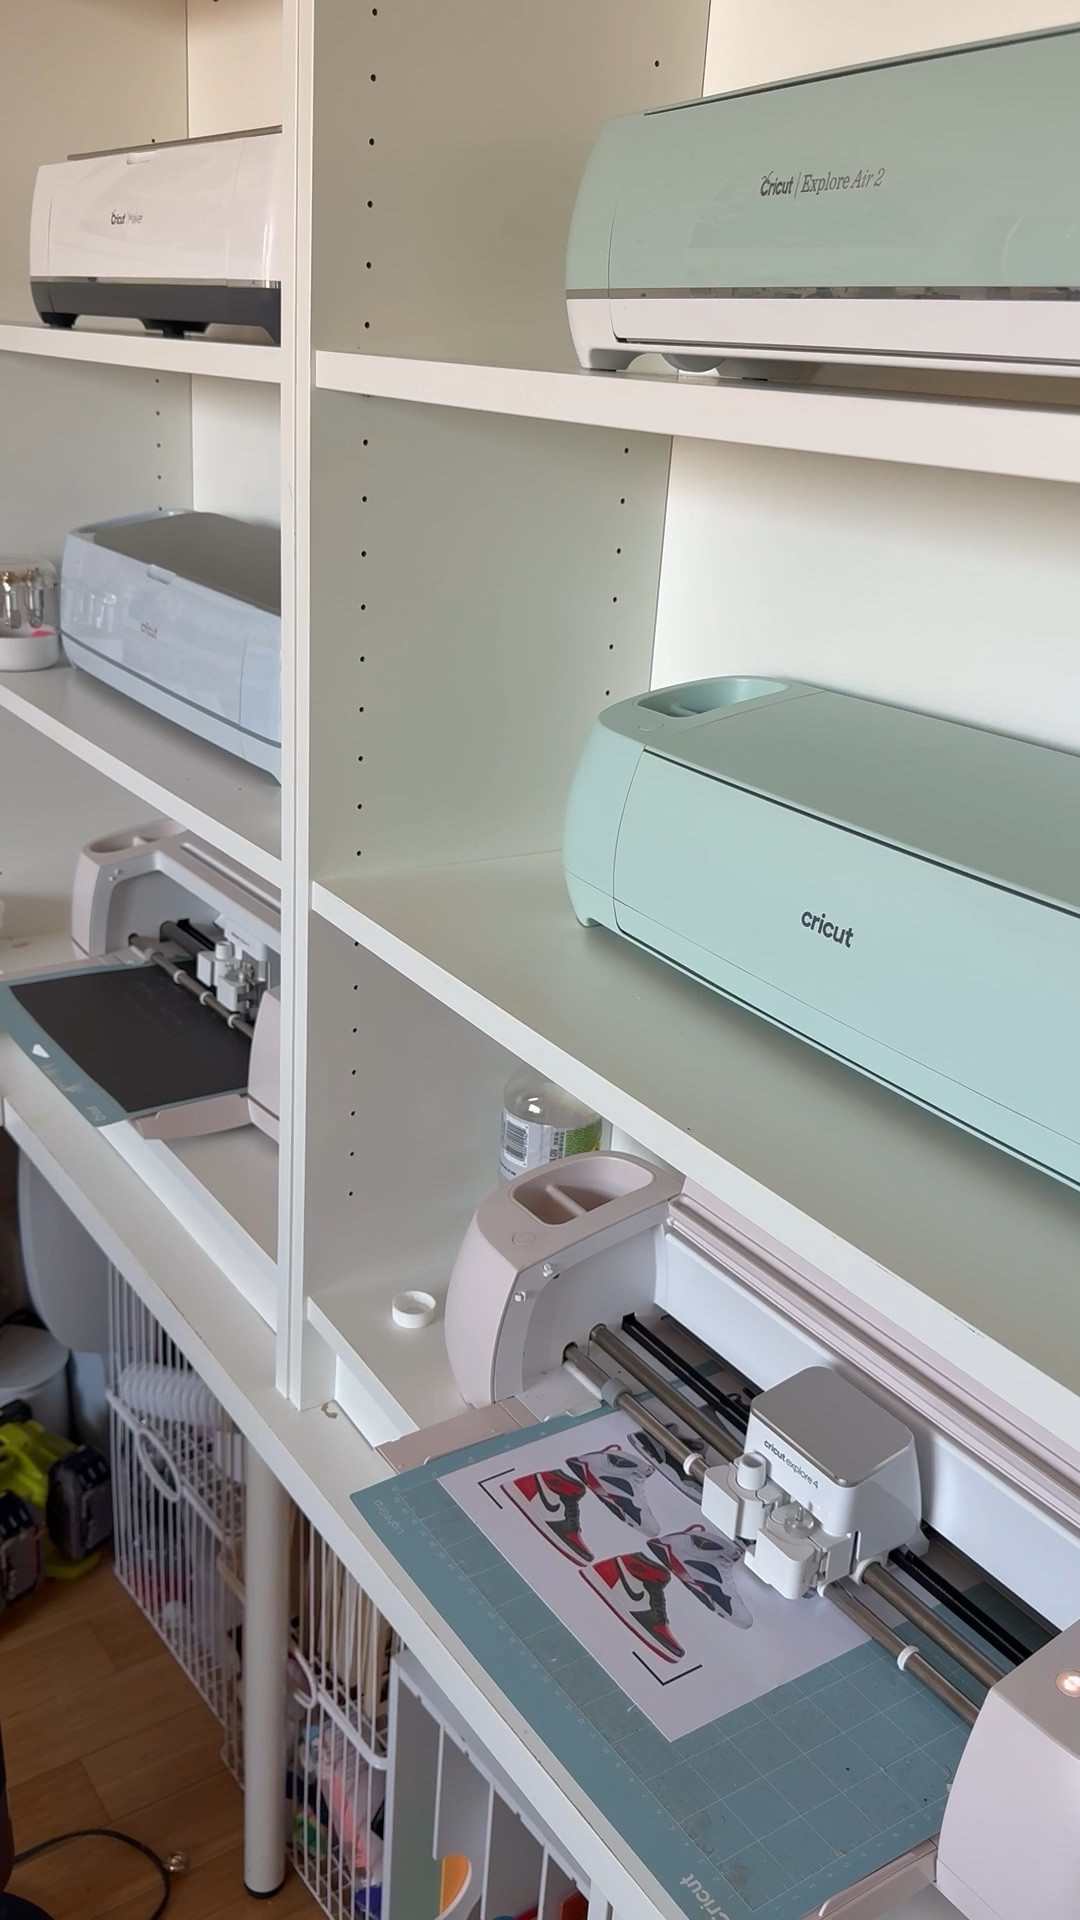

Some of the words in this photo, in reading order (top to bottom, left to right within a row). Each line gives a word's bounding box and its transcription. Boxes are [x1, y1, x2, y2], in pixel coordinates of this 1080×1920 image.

[760, 171, 794, 197] Cricut
[801, 172, 850, 195] Explore
[850, 169, 874, 189] Air
[874, 167, 885, 187] 2
[801, 910, 854, 948] cricut
[764, 1440, 786, 1463] cricut
[785, 1456, 813, 1485] explore
[812, 1480, 820, 1490] 4
